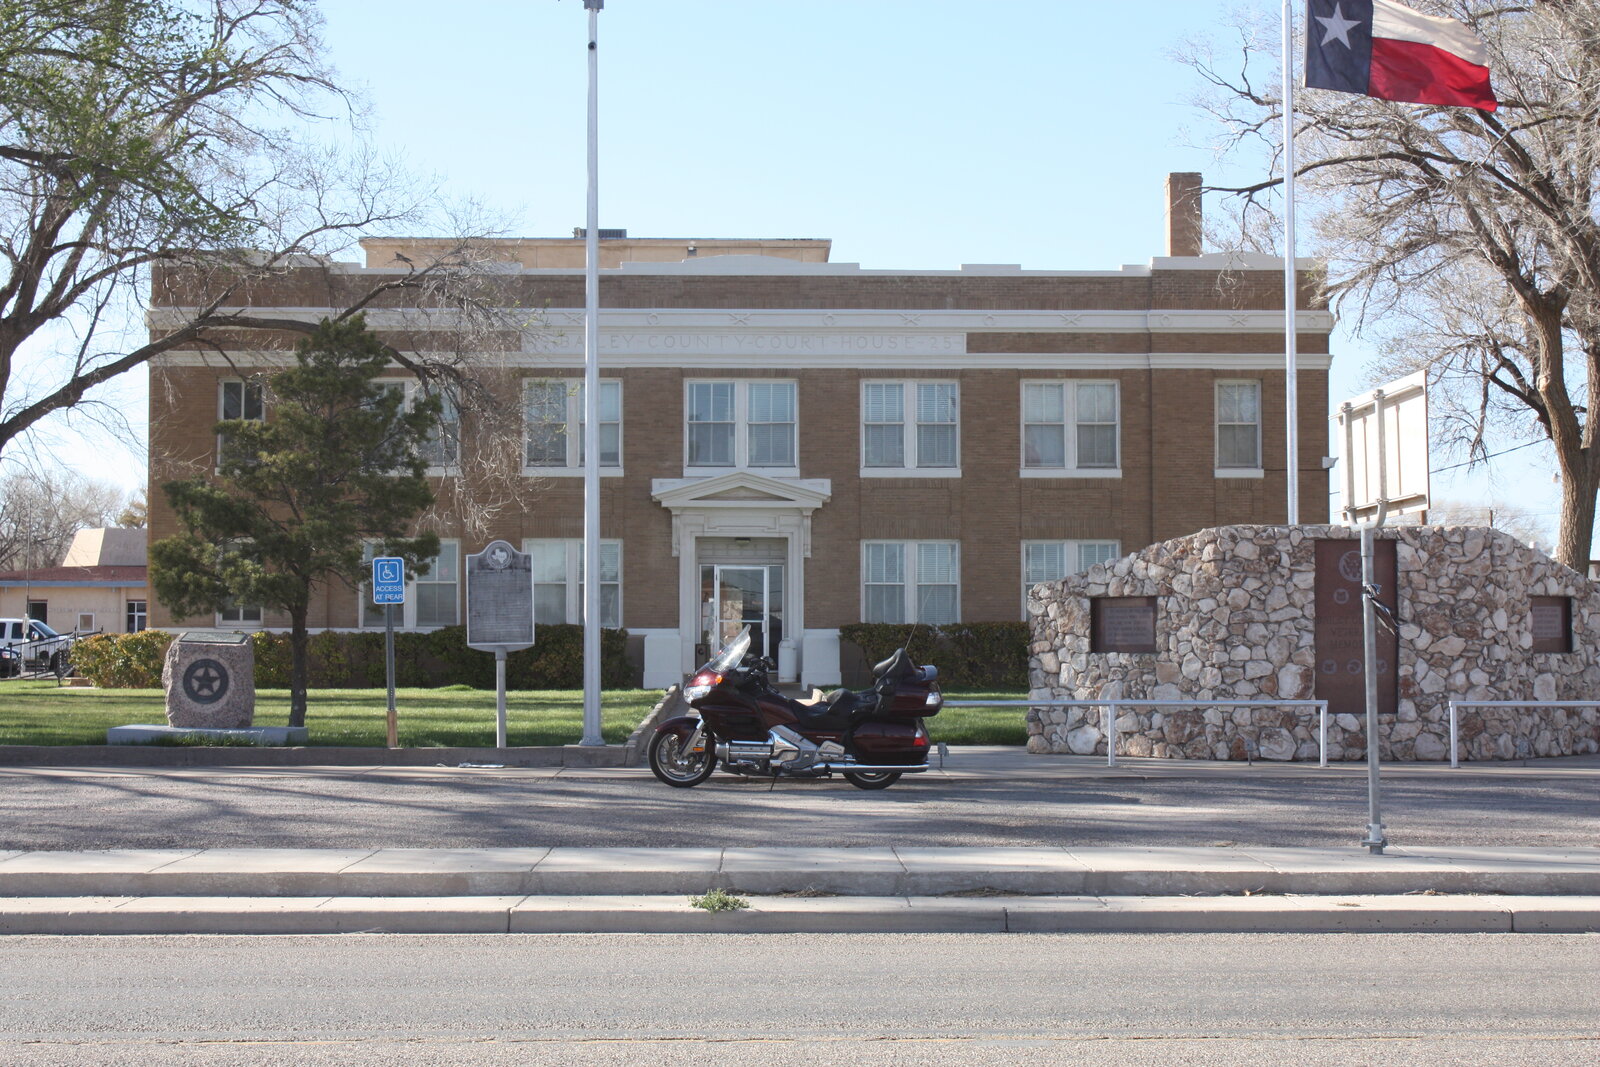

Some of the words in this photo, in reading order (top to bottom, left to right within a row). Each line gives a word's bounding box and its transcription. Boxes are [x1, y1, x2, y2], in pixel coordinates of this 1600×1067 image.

[559, 335, 635, 349] BALEY
[647, 335, 748, 349] COUNTY
[754, 335, 828, 349] COURT
[840, 335, 915, 350] HOUSE
